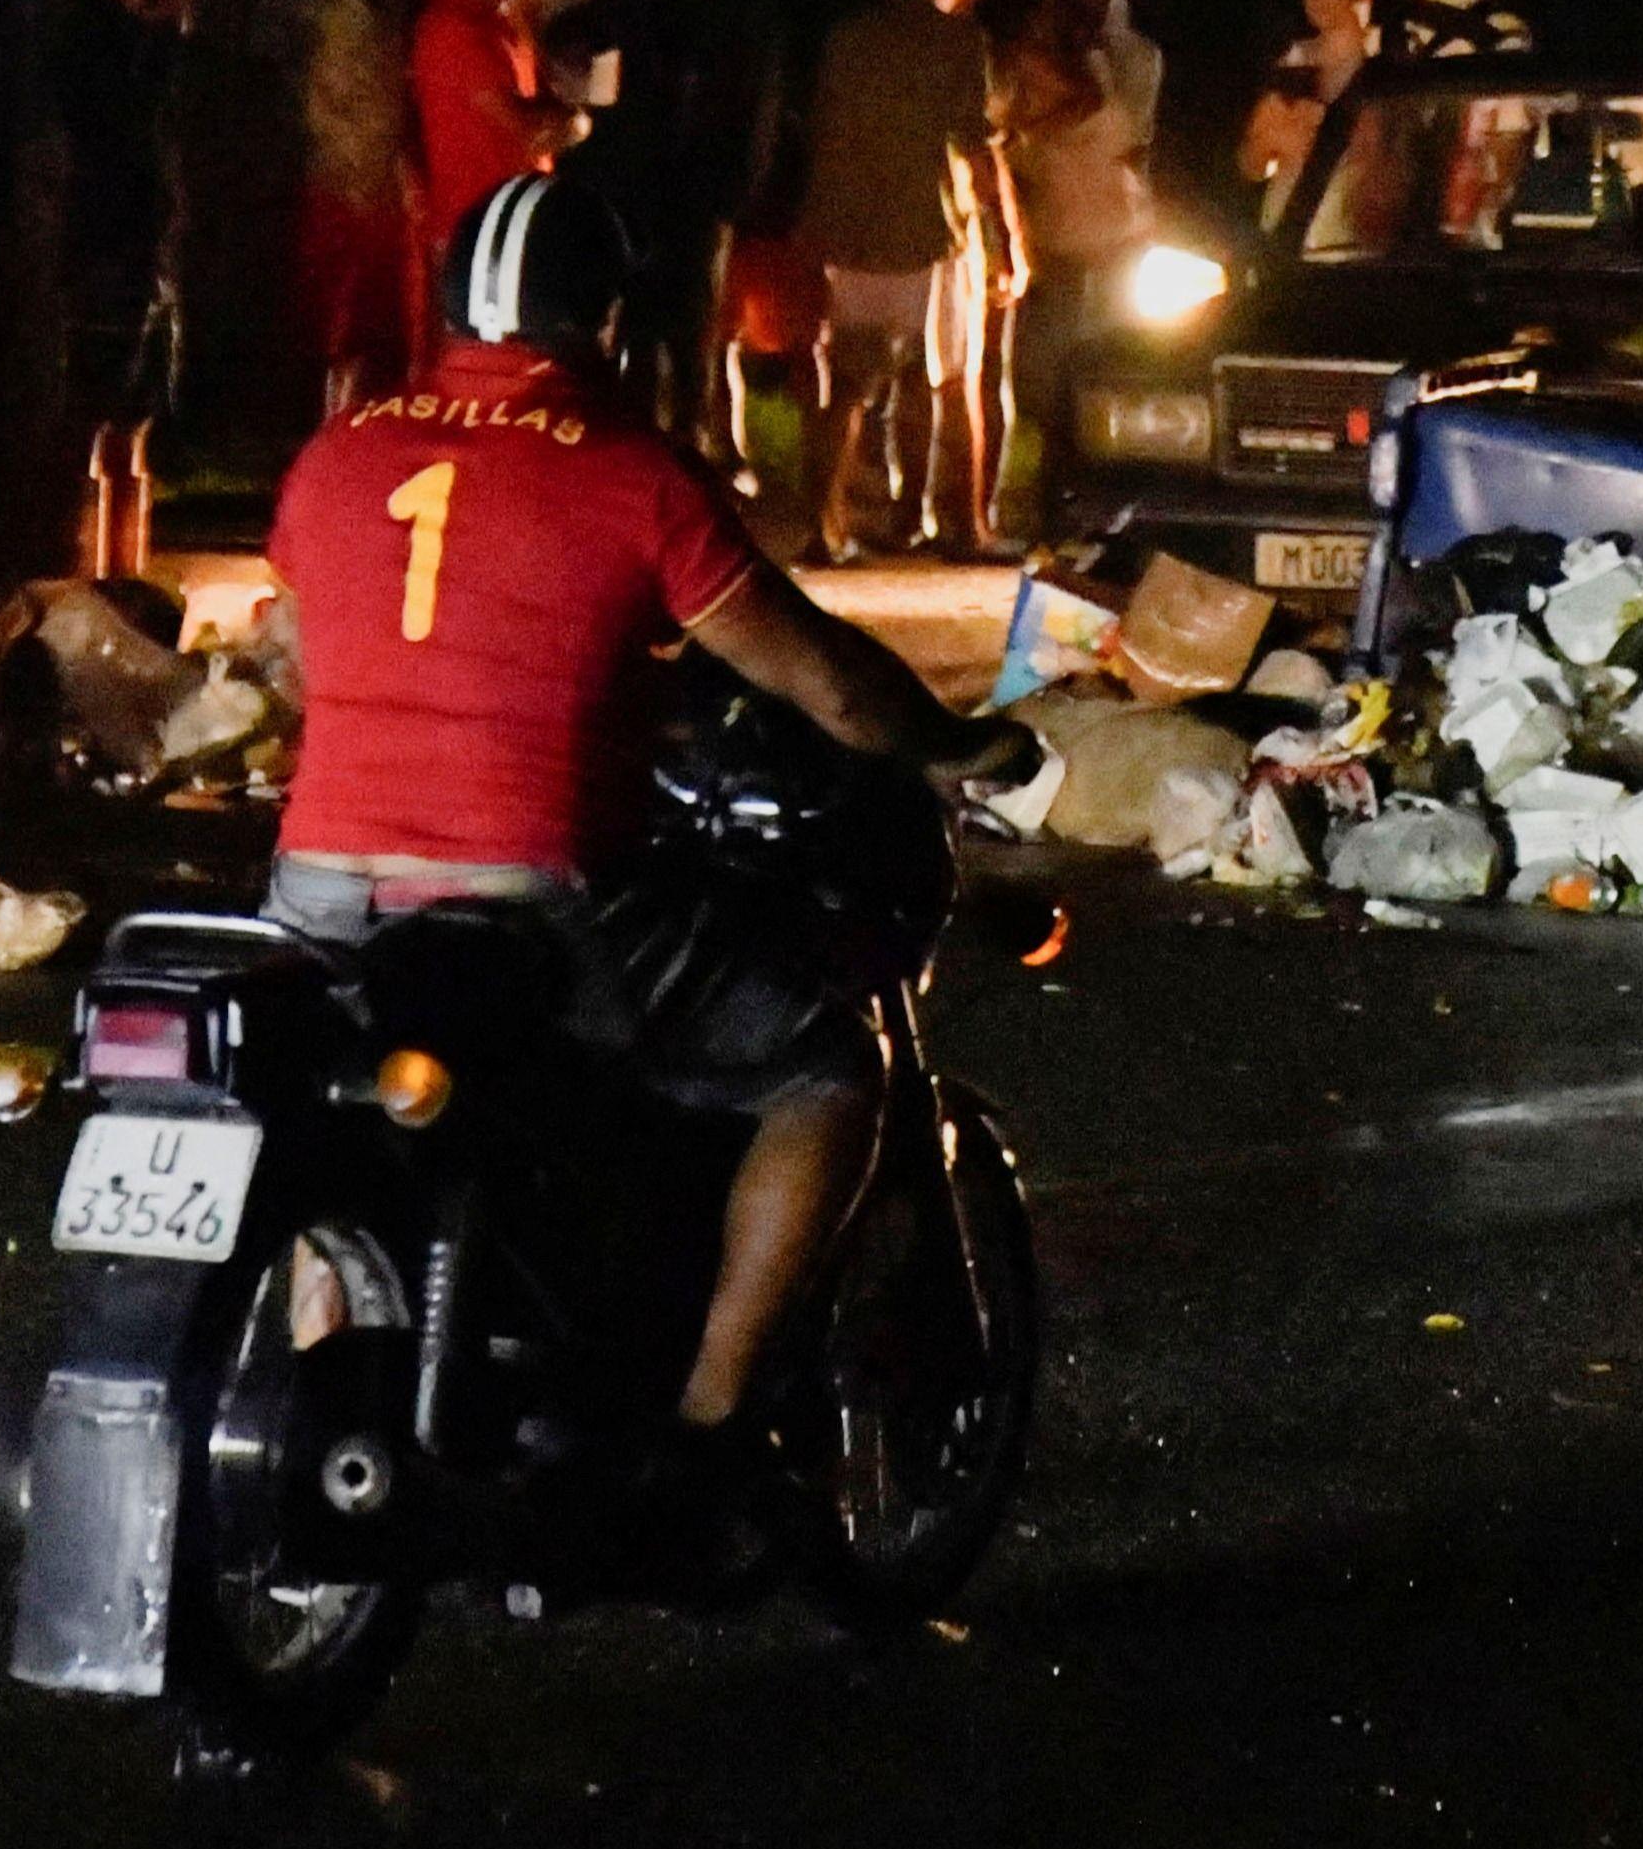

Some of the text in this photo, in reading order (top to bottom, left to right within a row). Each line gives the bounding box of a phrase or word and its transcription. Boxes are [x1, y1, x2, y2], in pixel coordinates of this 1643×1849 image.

[388, 462, 455, 642] 1
[149, 1131, 183, 1175] U
[68, 1182, 223, 1245] 33546
